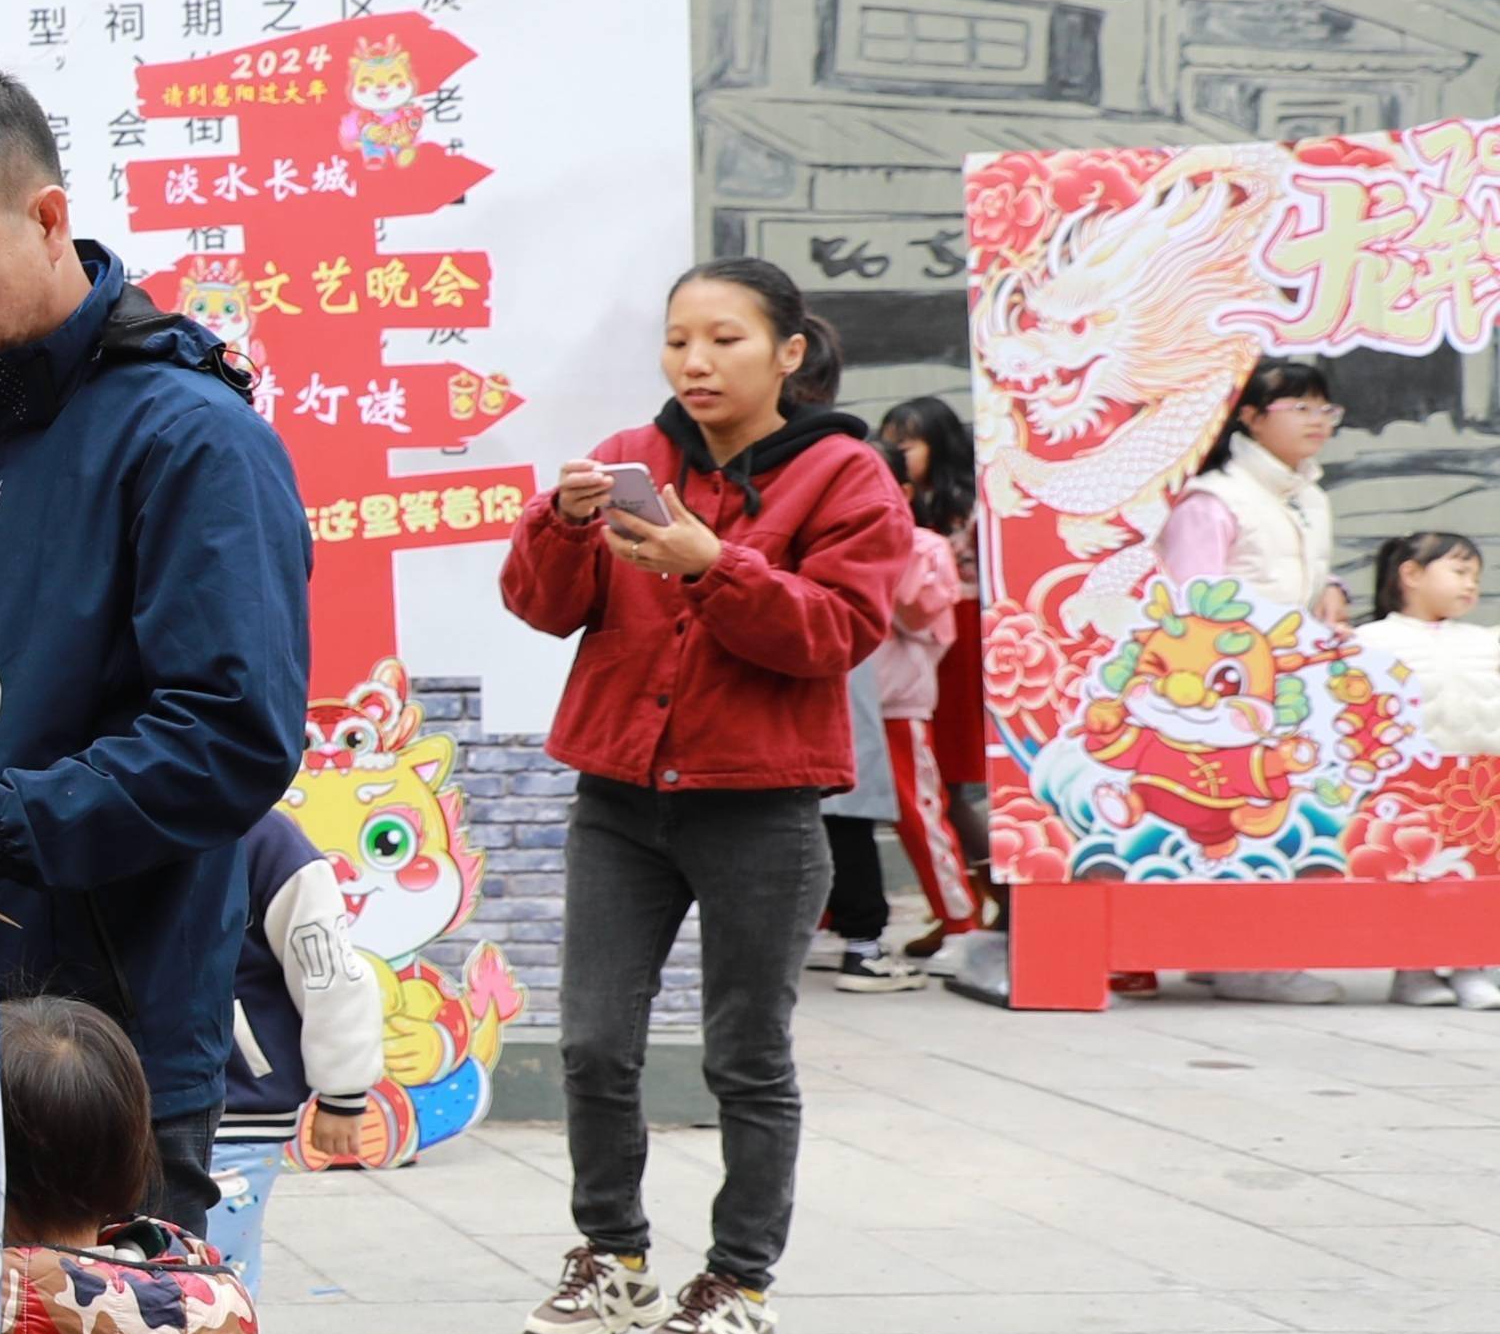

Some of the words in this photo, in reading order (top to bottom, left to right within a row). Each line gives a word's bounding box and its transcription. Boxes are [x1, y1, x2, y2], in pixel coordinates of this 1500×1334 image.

[232, 43, 333, 80] 2024
[161, 80, 329, 109] 请到惠阳过大年
[165, 155, 358, 205] 淡水长城
[250, 255, 481, 316] 文艺晚会
